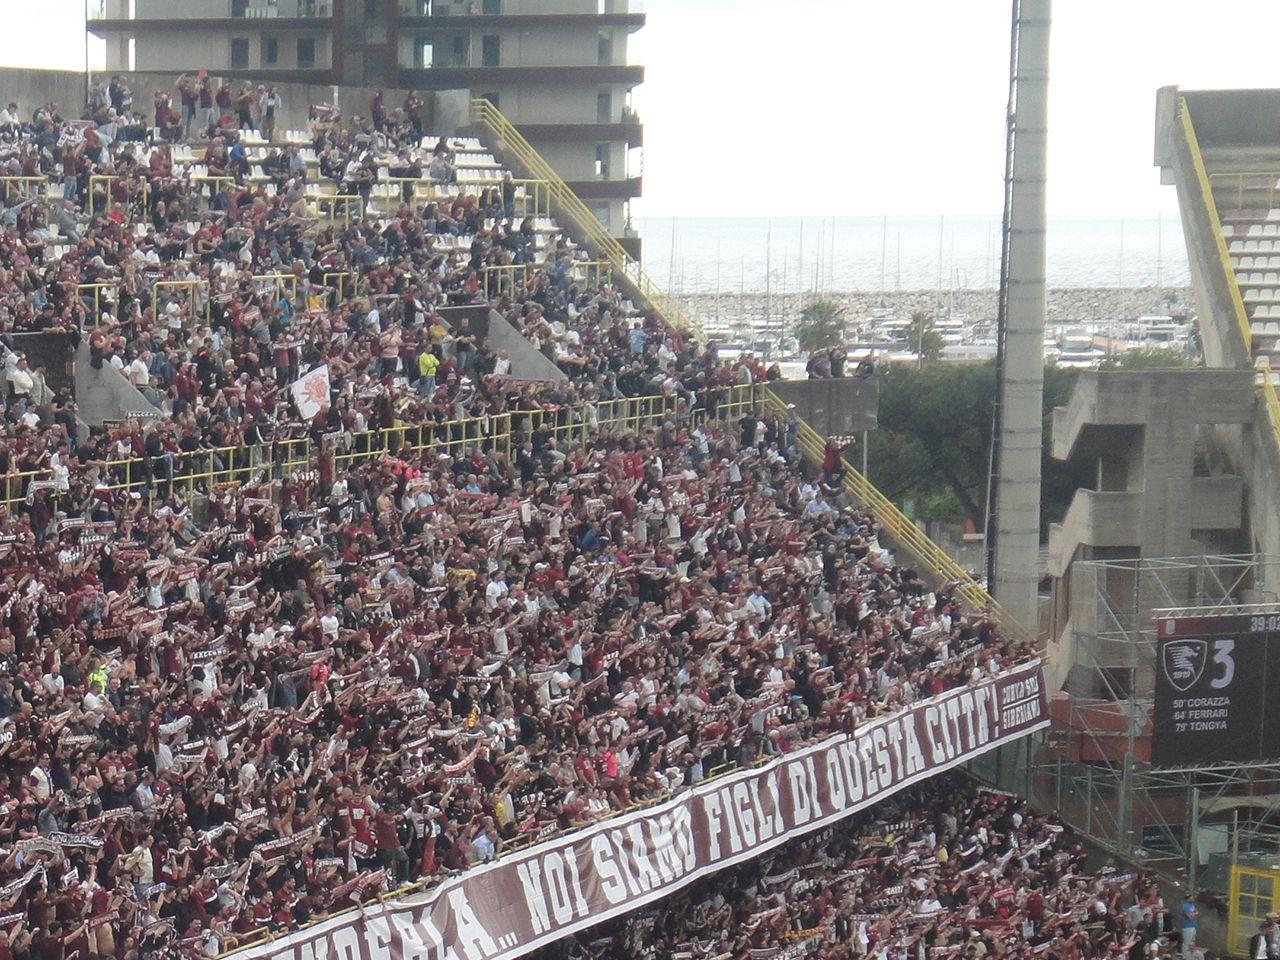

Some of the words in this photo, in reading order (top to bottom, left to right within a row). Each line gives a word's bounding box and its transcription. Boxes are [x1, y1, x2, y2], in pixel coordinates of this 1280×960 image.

[1211, 640, 1235, 688] 3
[1187, 697, 1231, 707] CORAZZA
[1188, 709, 1228, 718] FERRARI
[1190, 720, 1227, 731] TONGYA
[517, 845, 589, 936] NOI
[591, 803, 697, 904] SIAMO
[704, 770, 786, 861] FIGLI
[789, 756, 823, 825] DI
[826, 713, 926, 811] QUESTA
